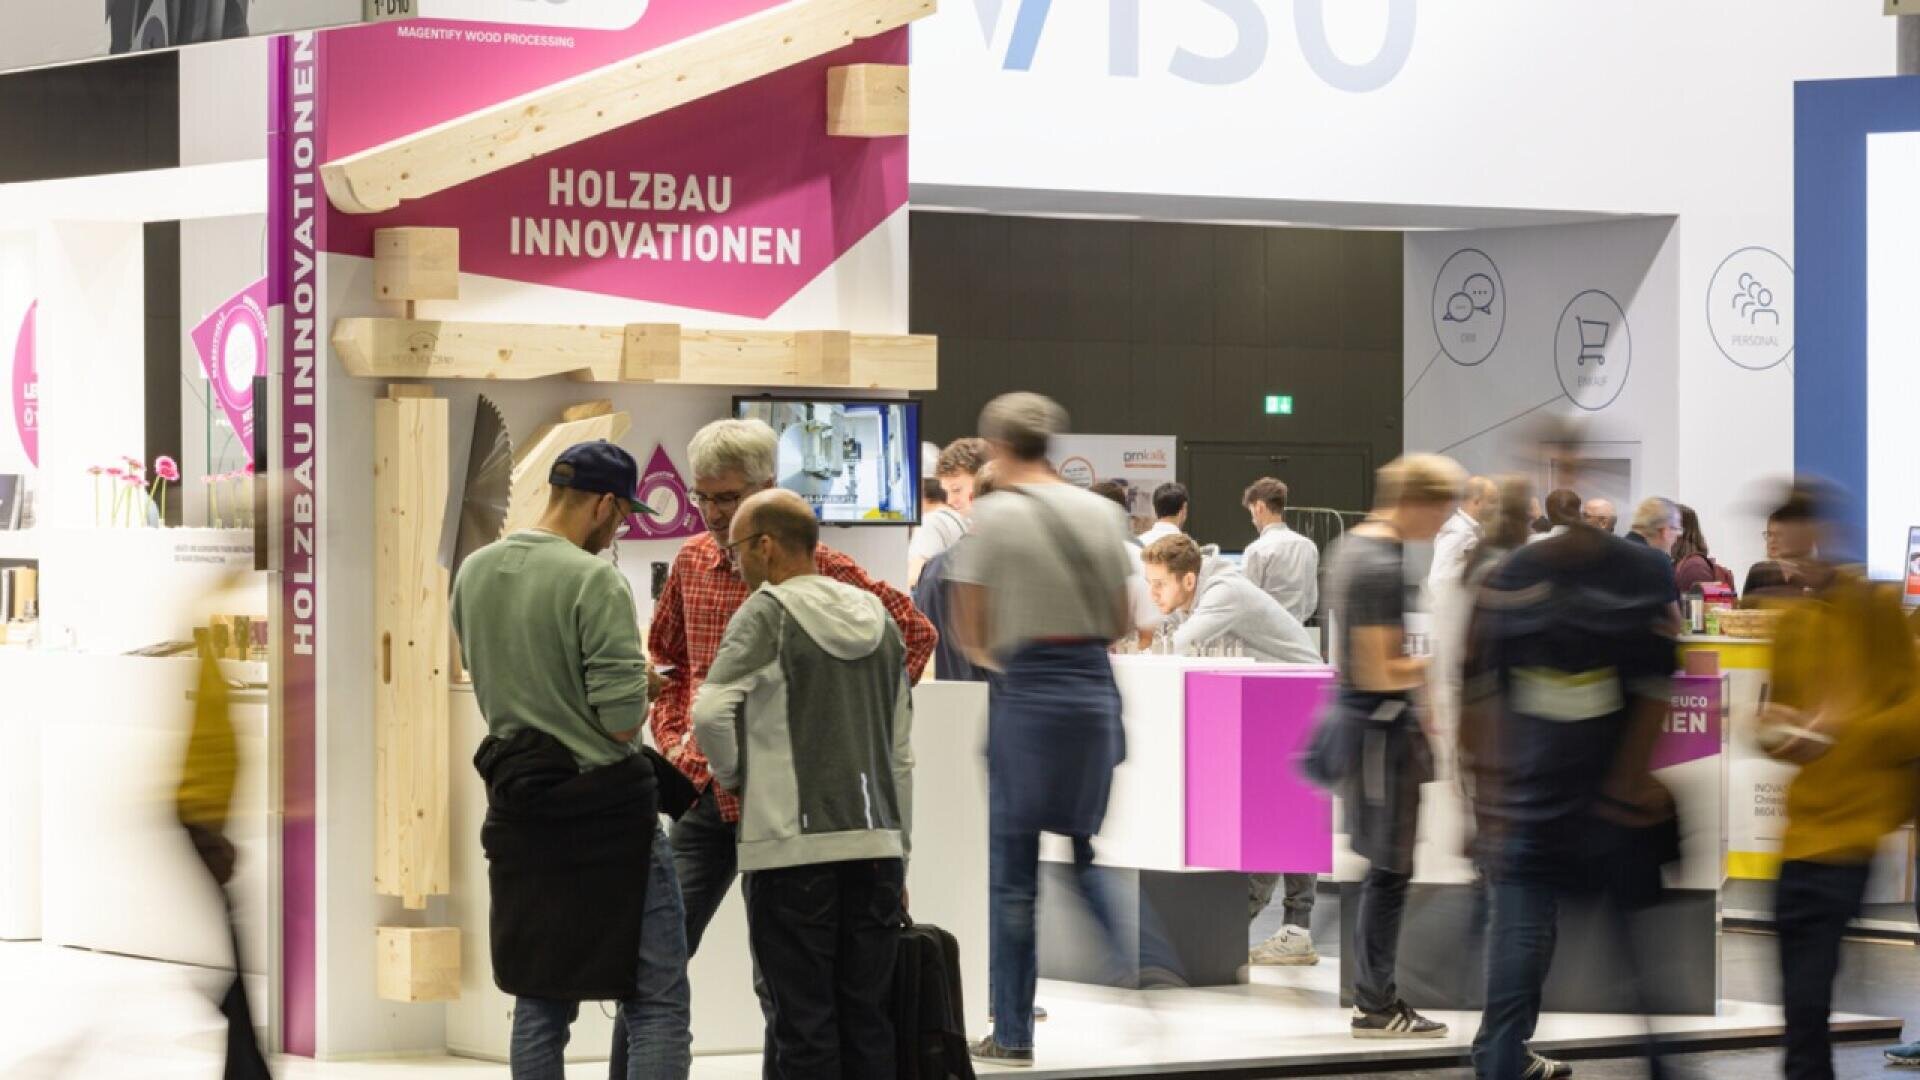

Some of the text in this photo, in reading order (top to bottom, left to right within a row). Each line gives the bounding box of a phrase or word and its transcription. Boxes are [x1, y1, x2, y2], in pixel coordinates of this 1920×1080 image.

[397, 26, 576, 48] MAGENTIFY WOOD PROCESSING
[548, 168, 732, 213] HOLZBAU
[510, 217, 801, 265] INNOVATIONEN
[293, 30, 314, 656] HOLZBAU INNOVATIONEN
[1731, 334, 1779, 347] PERSONAL
[1669, 695, 1708, 708] EUCO
